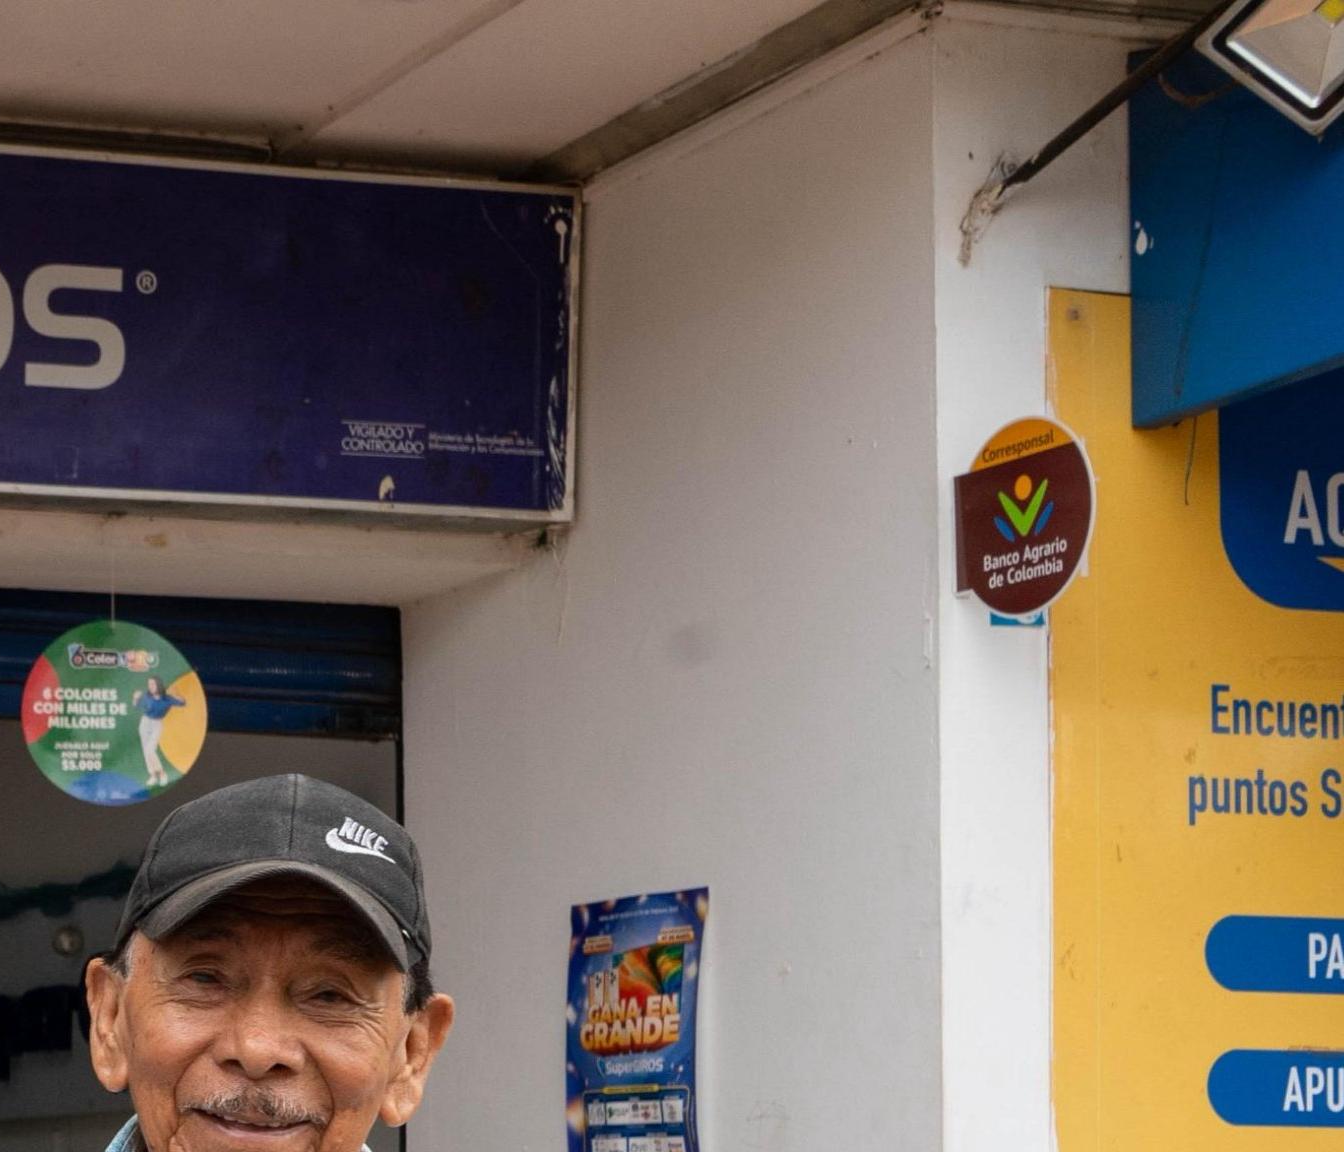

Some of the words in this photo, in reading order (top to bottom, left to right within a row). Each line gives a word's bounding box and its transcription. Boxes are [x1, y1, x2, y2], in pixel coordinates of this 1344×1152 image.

[341, 438, 425, 455] CONTROLADO
[981, 429, 1055, 464] Corresponsal
[983, 551, 1020, 573] Banco
[1023, 537, 1068, 564] Agrario
[988, 572, 1004, 590] de
[1007, 557, 1064, 586] Colombia
[33, 701, 64, 714] CON
[66, 702, 106, 715] MILES
[108, 702, 128, 716] DE
[53, 687, 117, 701] COLORES
[47, 715, 116, 729] MILLONES
[1188, 768, 1308, 826] puntos
[338, 816, 389, 852] NIKE
[580, 1013, 681, 1051] GRANDE
